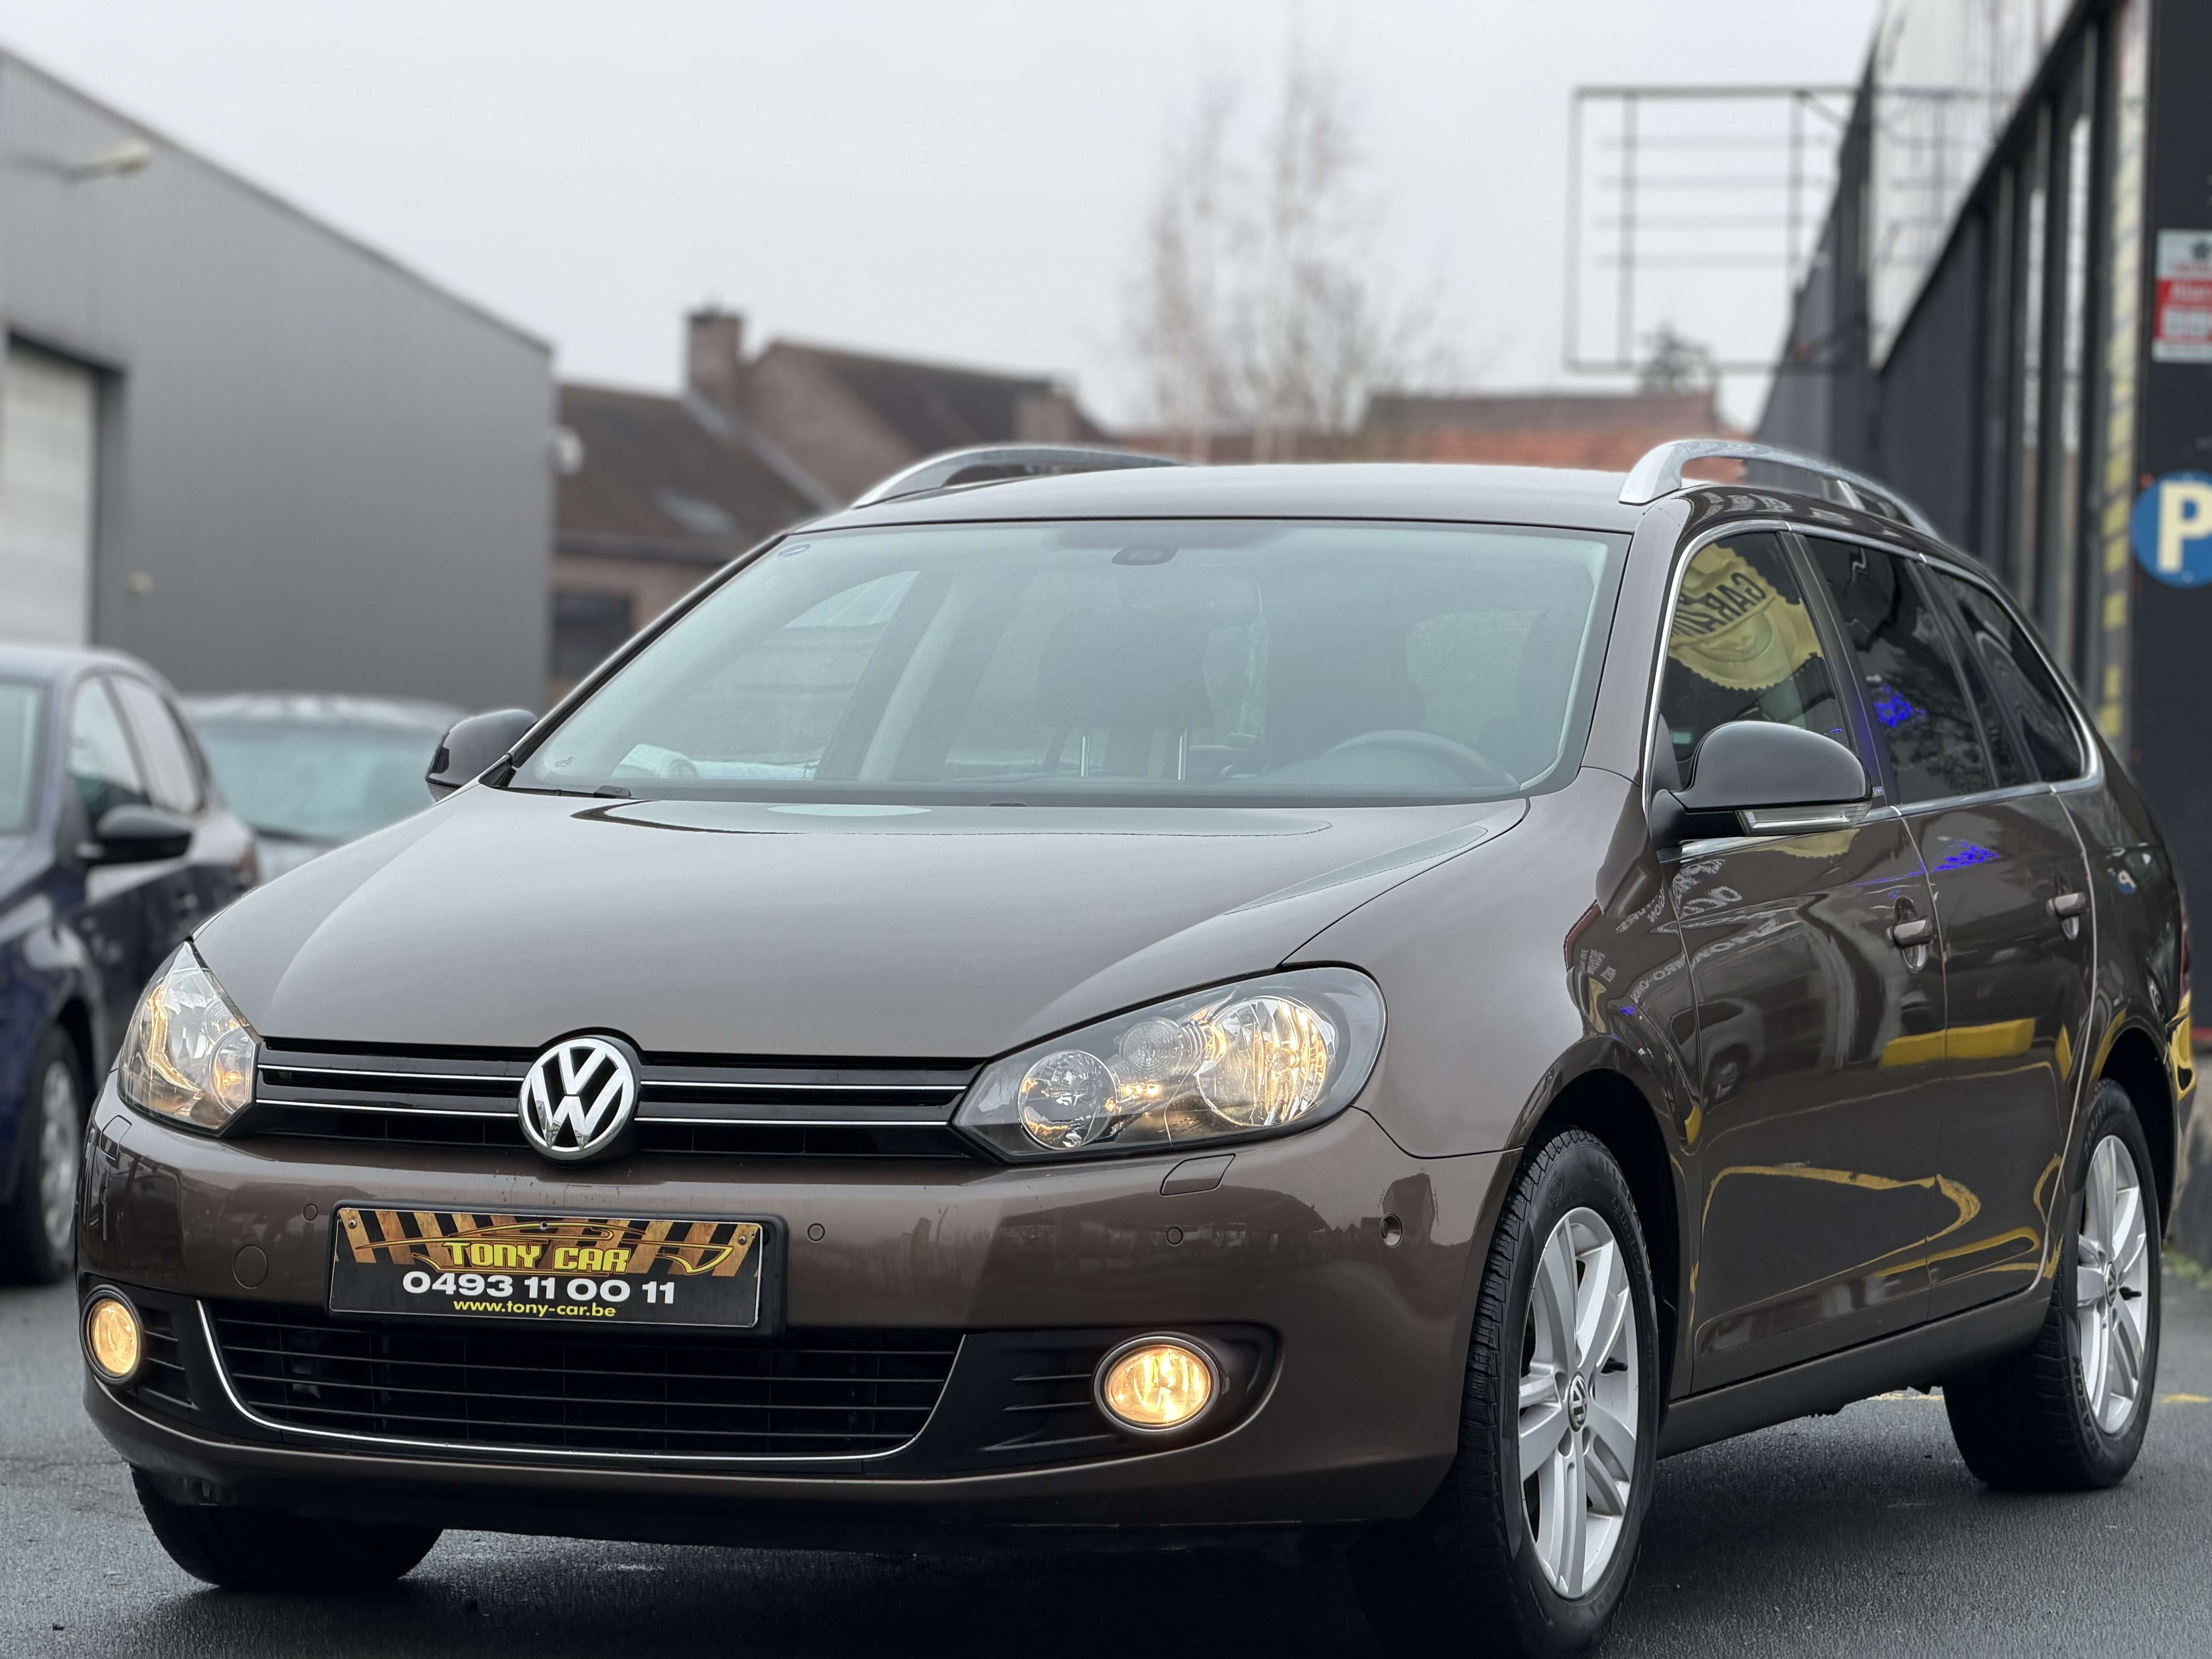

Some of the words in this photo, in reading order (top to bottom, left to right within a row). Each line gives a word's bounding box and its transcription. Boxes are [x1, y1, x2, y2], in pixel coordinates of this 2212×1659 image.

[2157, 480, 2212, 573] P
[442, 1242, 541, 1269] TONY
[553, 1247, 630, 1273] CAR
[403, 1271, 513, 1297] 0493
[524, 1276, 555, 1299] 11
[567, 1278, 630, 1302] 00
[642, 1281, 675, 1304] 11
[453, 1300, 616, 1317] www.tony-car.be
